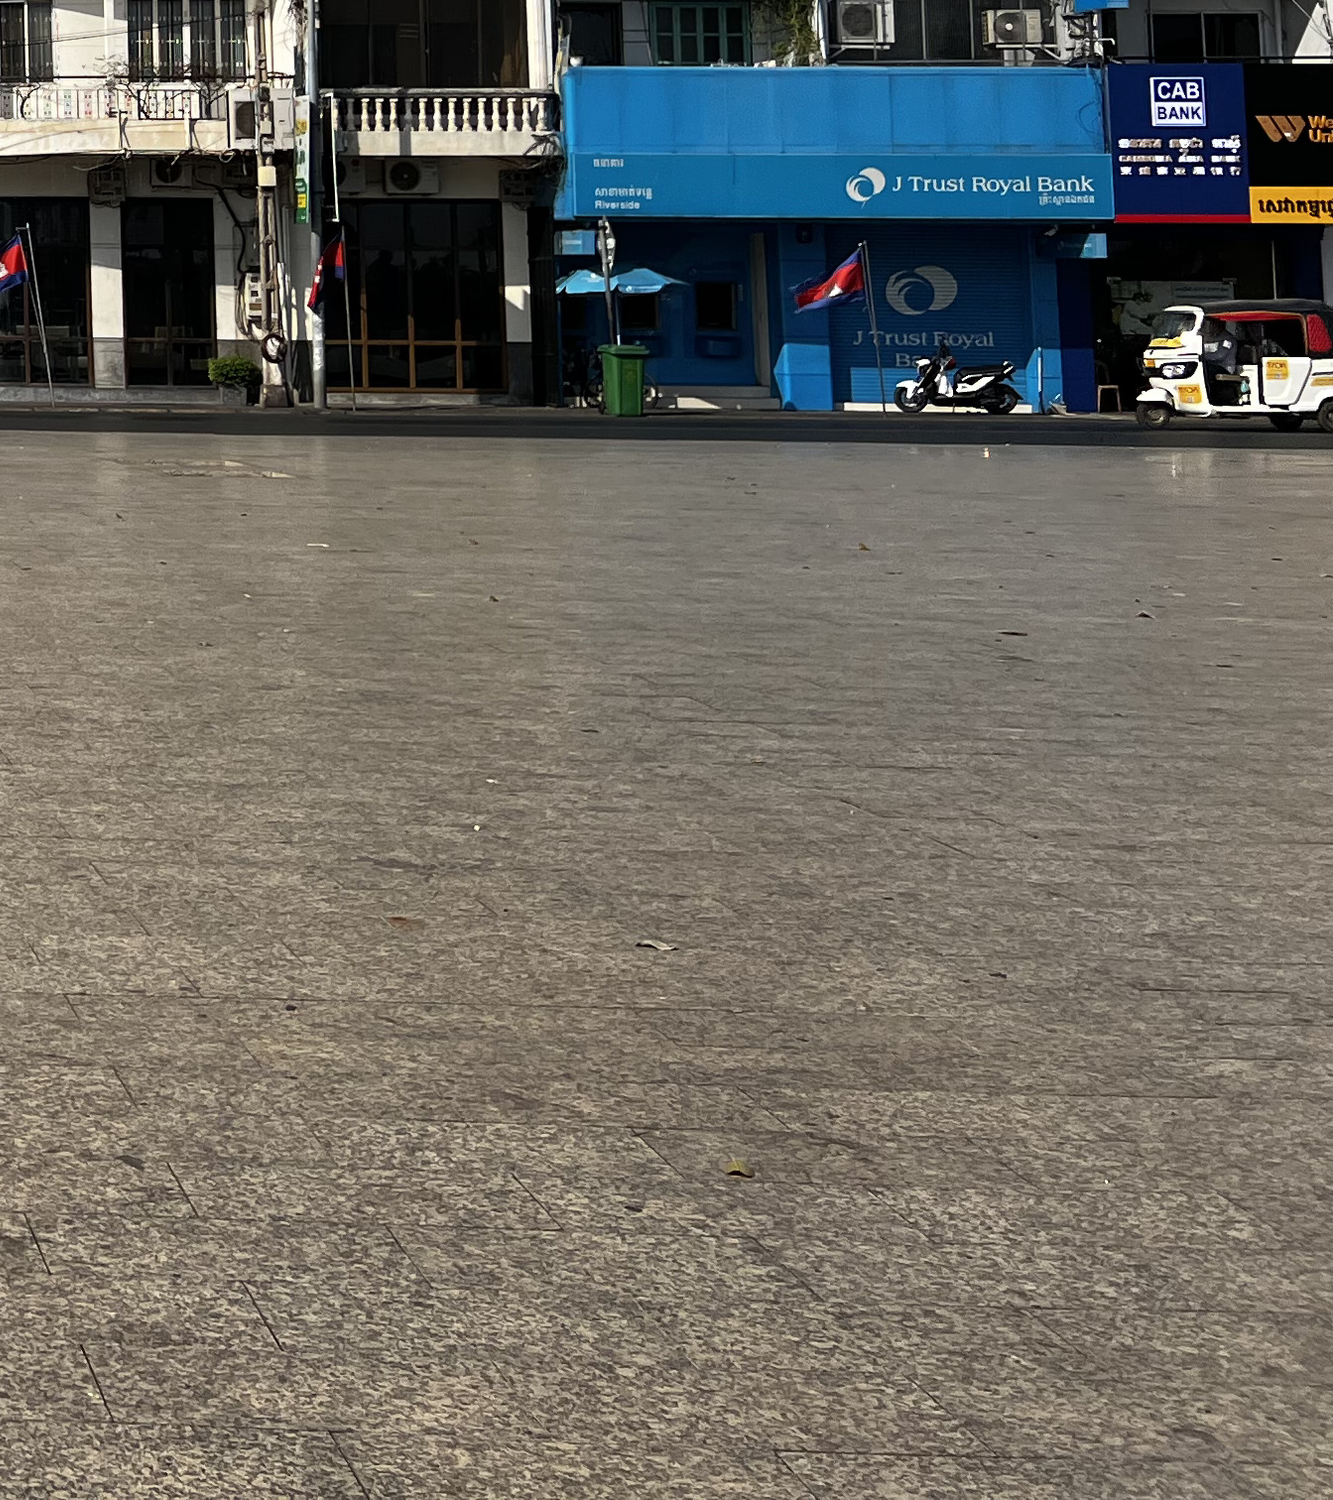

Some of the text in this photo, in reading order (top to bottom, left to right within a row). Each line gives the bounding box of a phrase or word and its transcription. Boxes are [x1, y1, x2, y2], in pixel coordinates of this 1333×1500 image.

[1157, 82, 1200, 99] CAB
[1157, 106, 1202, 120] BANK
[892, 175, 1094, 196] J Trust Royal Bank
[594, 200, 641, 210] Riverside
[853, 330, 863, 345] J
[933, 331, 994, 350] Royal
